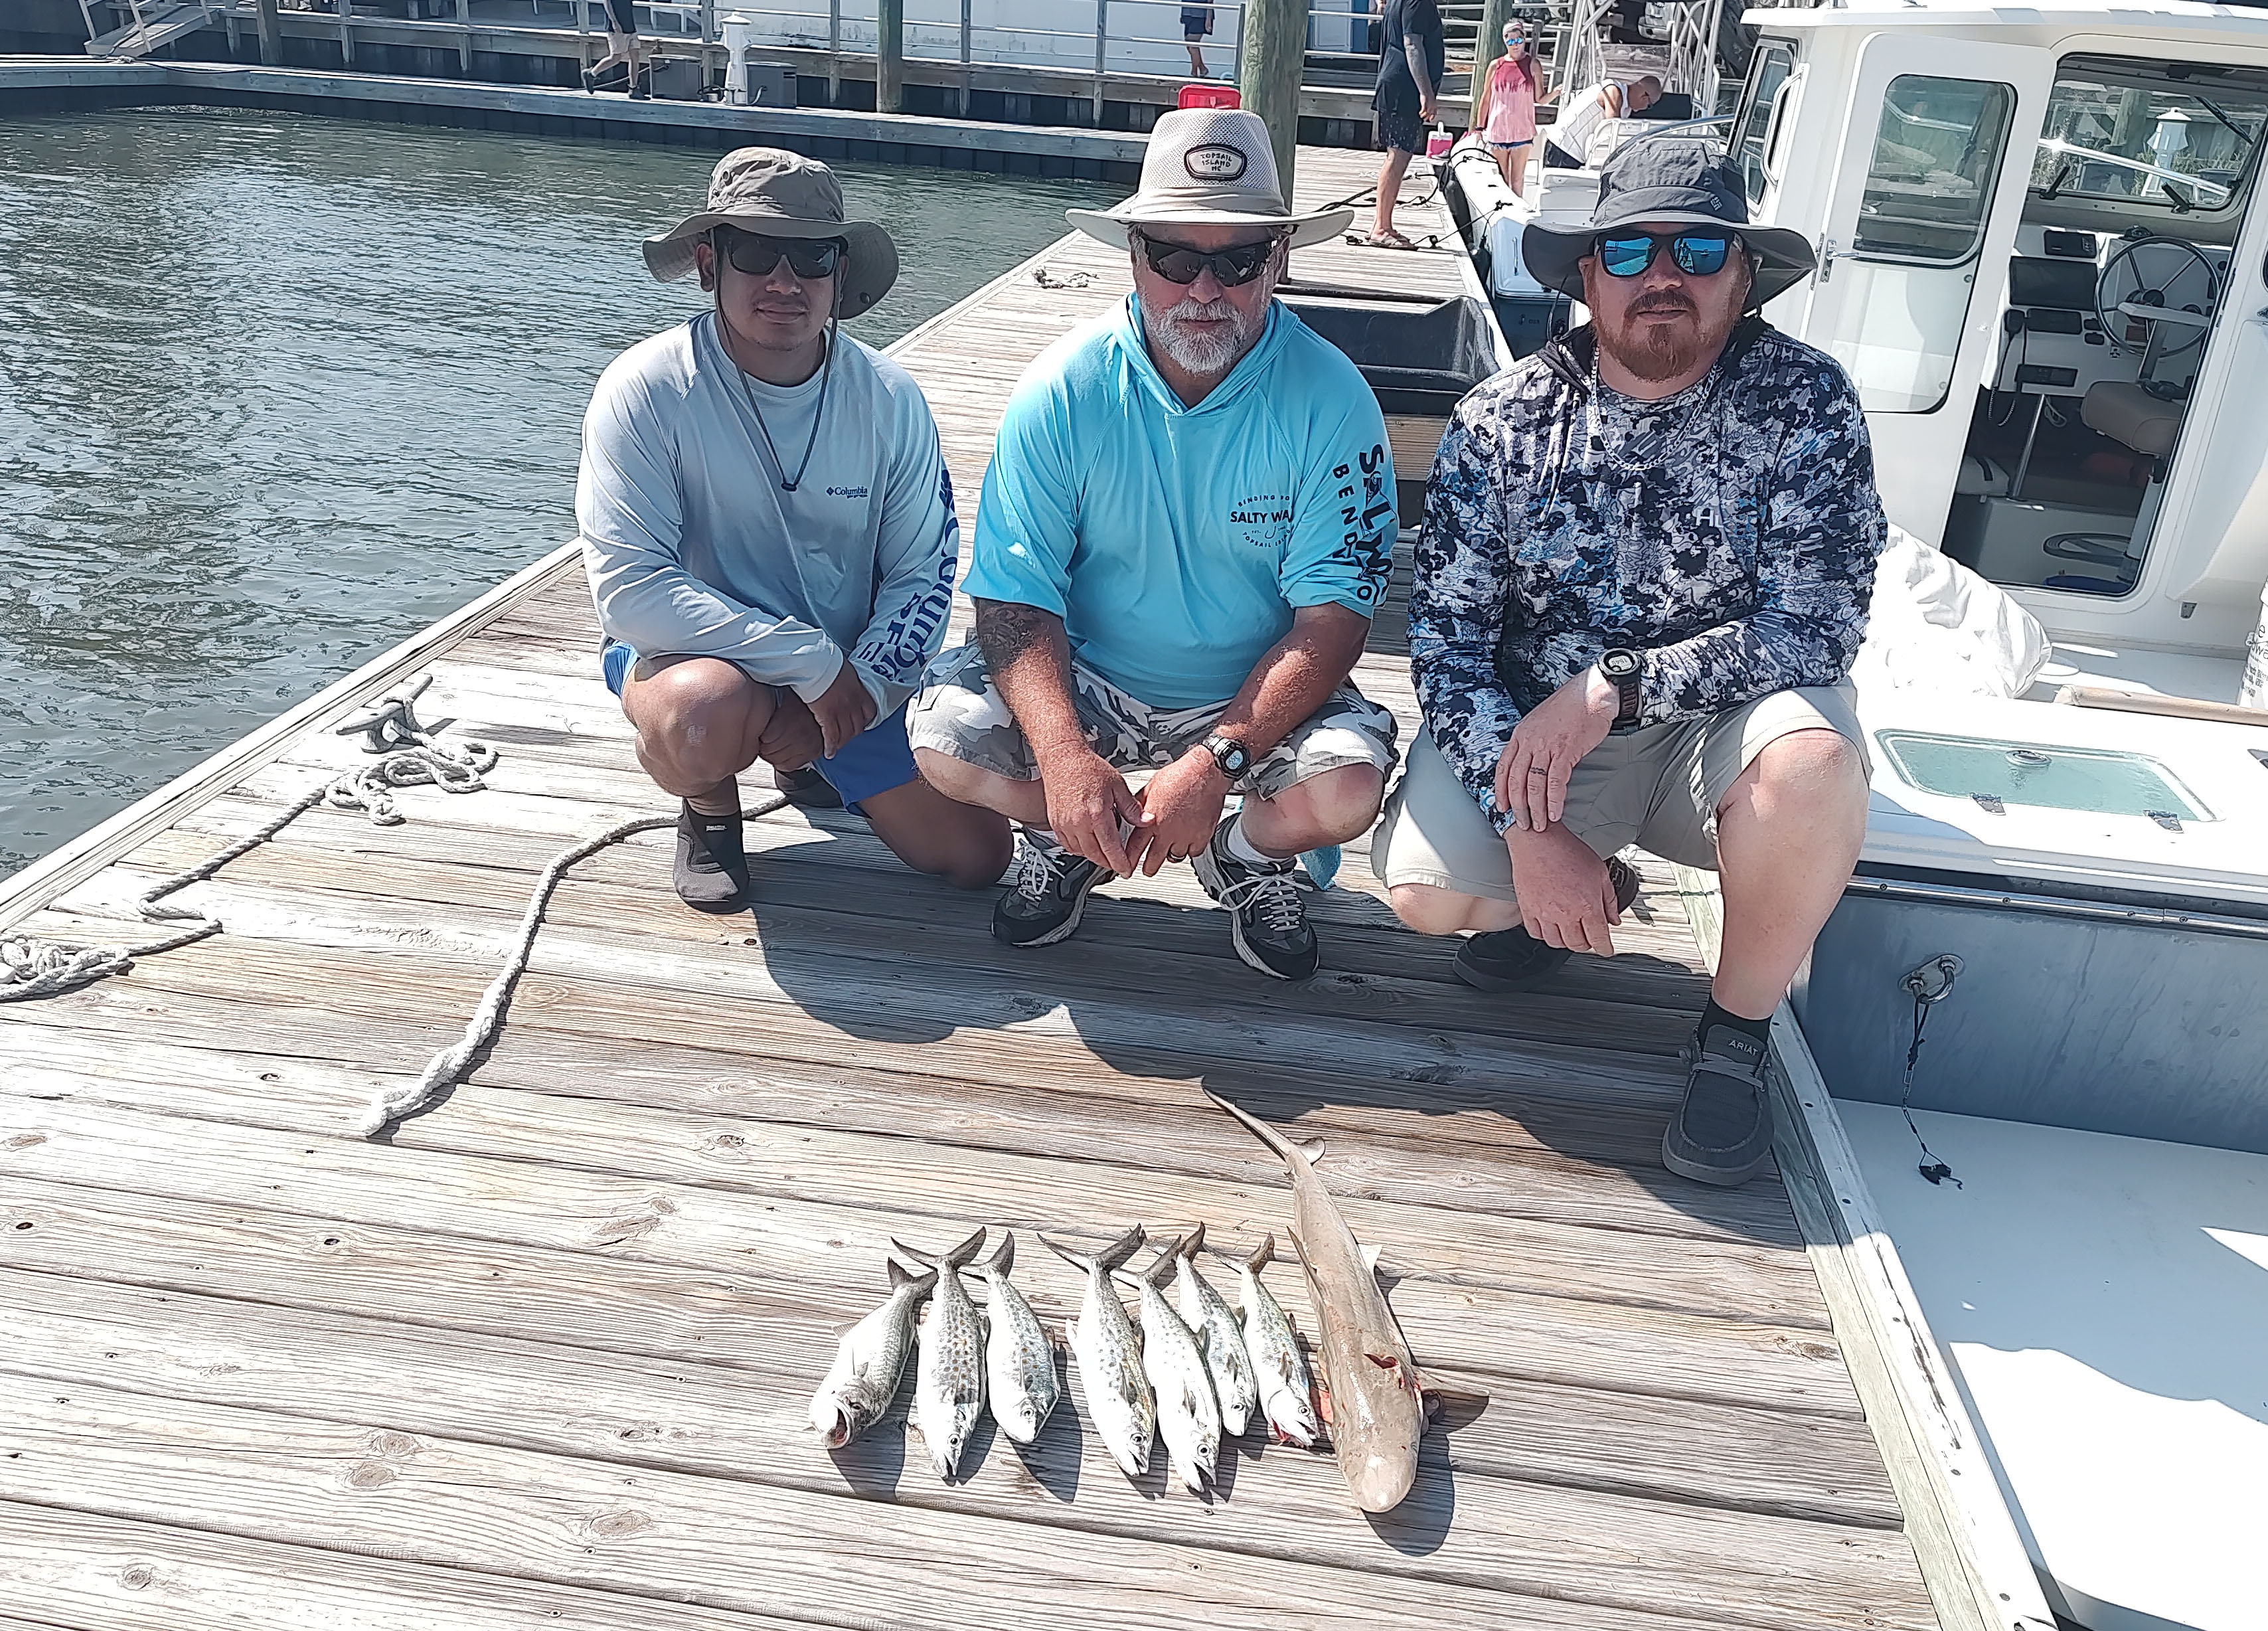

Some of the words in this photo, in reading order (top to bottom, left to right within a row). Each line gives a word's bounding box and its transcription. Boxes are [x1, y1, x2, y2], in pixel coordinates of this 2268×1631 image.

[1202, 159, 1232, 168] ISLAND
[835, 485, 868, 496] Columbia
[1230, 511, 1269, 524] SALTY
[1242, 531, 1272, 548] TOPSAIL
[1728, 1039, 1759, 1057] ARIAT
